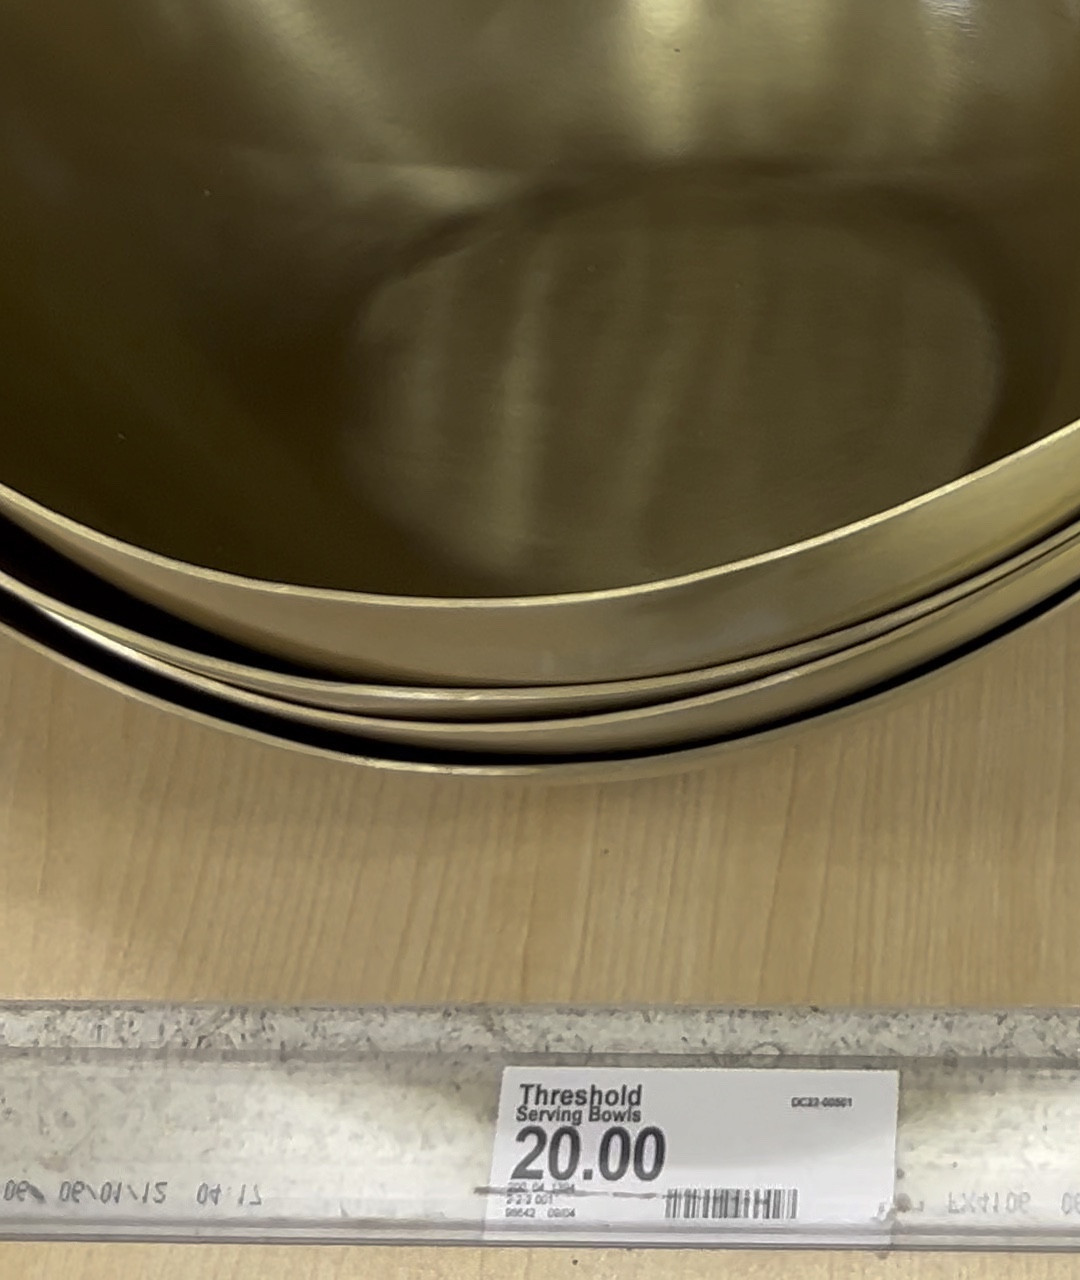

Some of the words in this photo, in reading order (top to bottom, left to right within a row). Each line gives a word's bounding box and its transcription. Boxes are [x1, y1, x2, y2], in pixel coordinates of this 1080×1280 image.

[519, 1083, 643, 1106] Threshold
[516, 1105, 583, 1126] Serving
[588, 1105, 642, 1123] Bowls
[510, 1125, 667, 1182] 20.00
